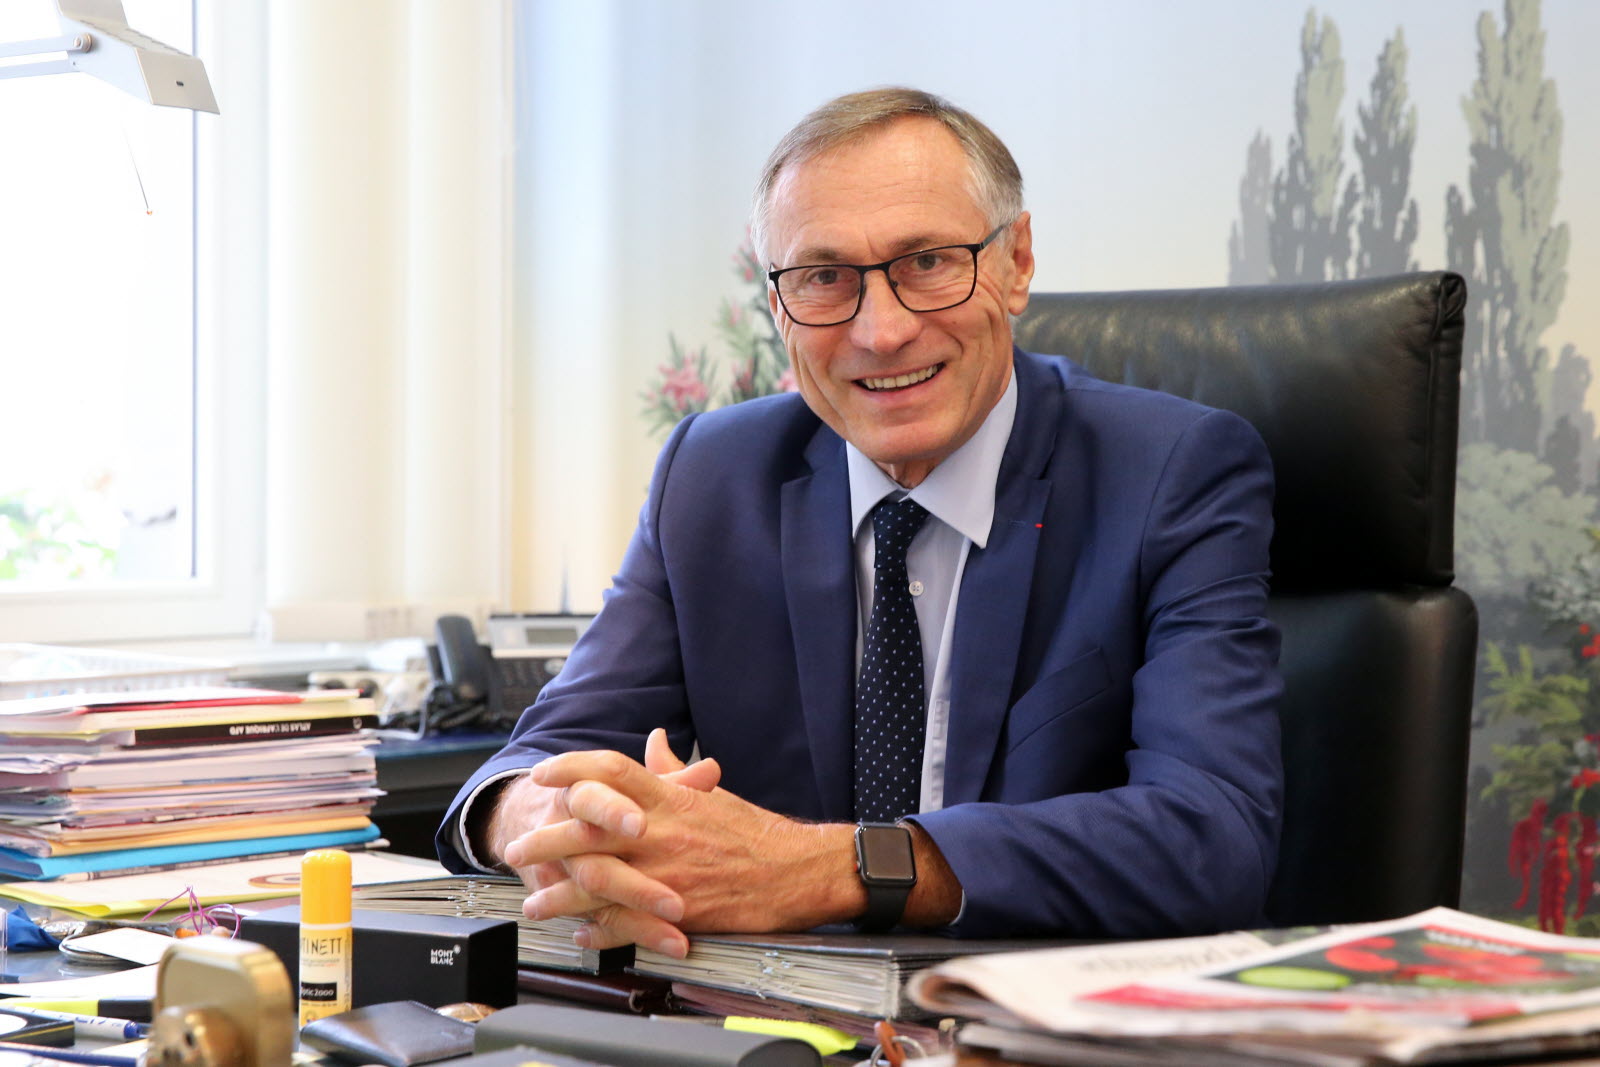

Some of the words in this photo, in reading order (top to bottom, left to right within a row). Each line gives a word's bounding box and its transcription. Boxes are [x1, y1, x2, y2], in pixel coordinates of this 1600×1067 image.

[289, 722, 311, 732] ATLAS
[430, 949, 454, 957] MONT
[430, 957, 454, 966] BLANC
